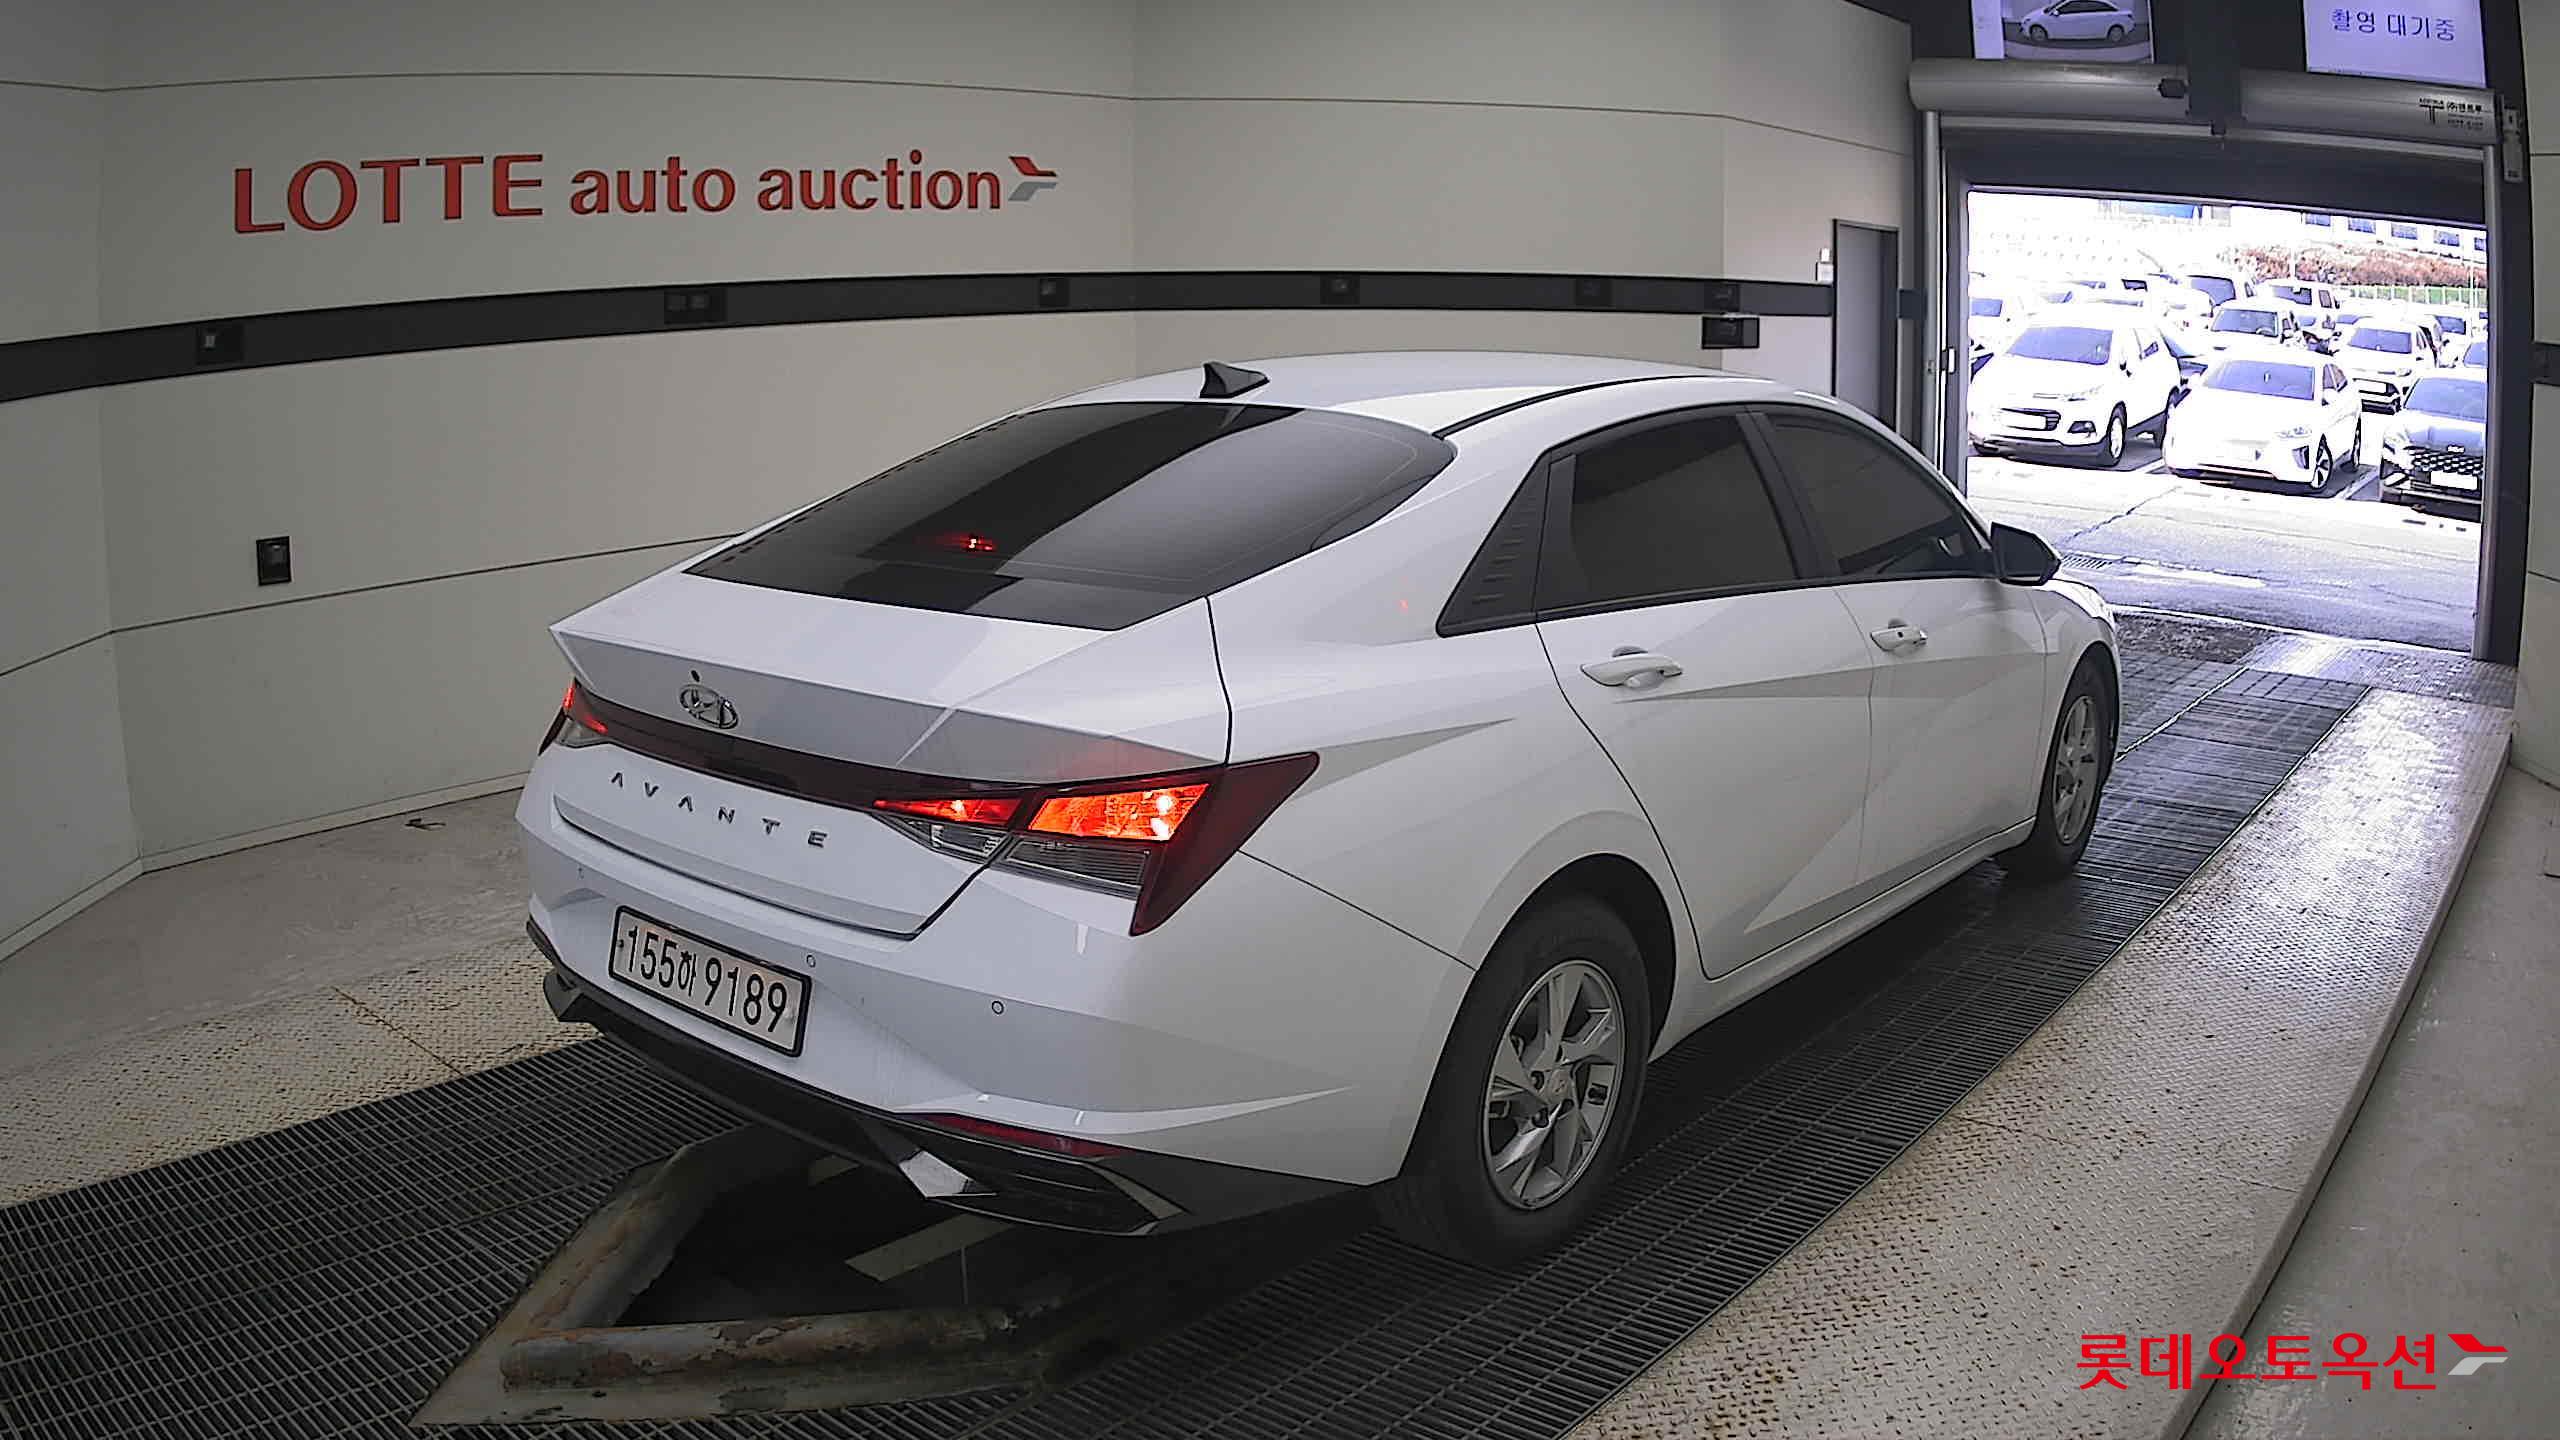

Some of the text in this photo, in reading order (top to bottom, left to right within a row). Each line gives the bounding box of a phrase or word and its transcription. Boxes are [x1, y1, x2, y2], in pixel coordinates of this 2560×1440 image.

[2333, 9, 2456, 41] 촬영 대기중
[234, 148, 1001, 234] LOTTE auto auction
[610, 771, 828, 849] AVANTE
